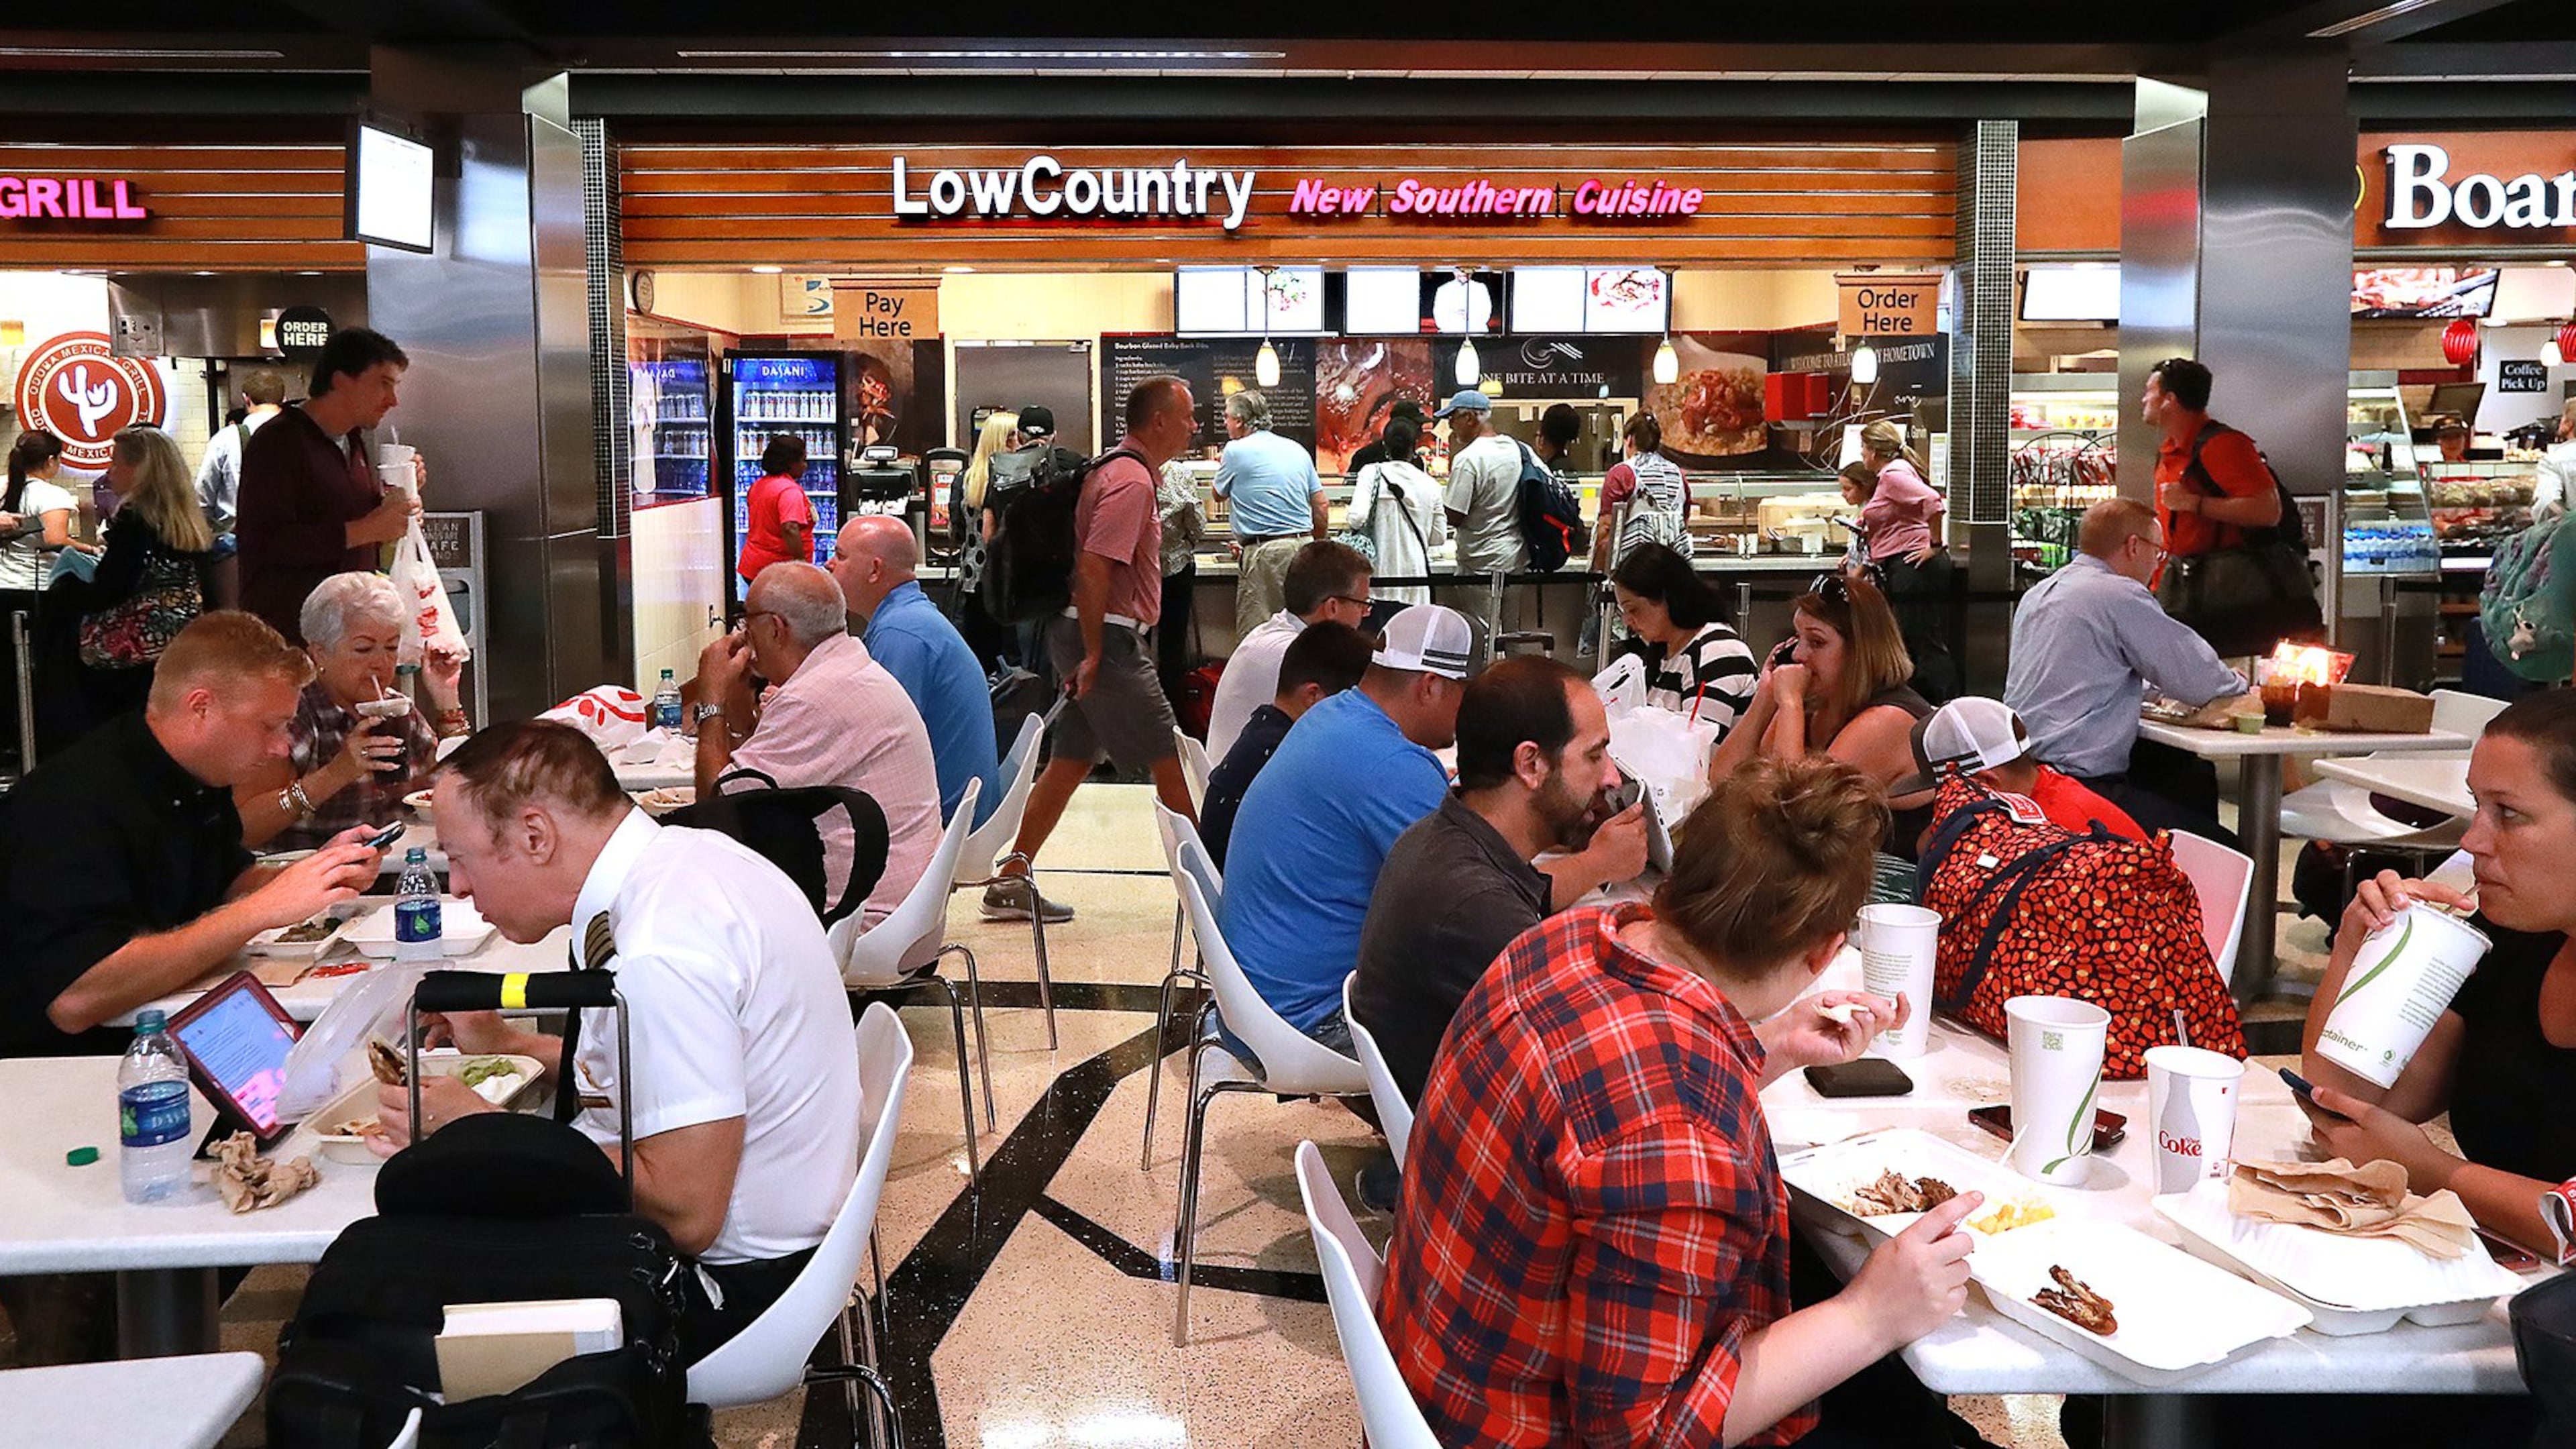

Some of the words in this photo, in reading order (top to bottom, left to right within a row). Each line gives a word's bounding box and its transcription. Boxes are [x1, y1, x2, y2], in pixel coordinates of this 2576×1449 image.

[0, 177, 146, 219] GRILL
[892, 154, 1256, 230] LowCountry
[1290, 178, 1375, 213] New
[1390, 178, 1554, 214] Southern
[1574, 179, 1704, 214] Cuisine
[866, 292, 904, 318] Pay
[1858, 288, 1919, 309] Order
[282, 321, 328, 333] ORDER
[859, 317, 912, 337] Here
[1863, 313, 1913, 332] Here
[283, 332, 329, 347] HERE
[1883, 343, 1935, 363] HOMETOWN
[60, 344, 119, 363] MEXICA
[121, 362, 147, 396] GRILL
[761, 366, 805, 377] DASANI
[1505, 372, 1536, 384] BITE
[1537, 372, 1556, 384] AT
[1558, 373, 1568, 384] A
[1570, 372, 1605, 384] TIME
[2504, 363, 2543, 376] Coffee
[2502, 378, 2524, 389] Pick
[2528, 378, 2546, 391] Up
[429, 540, 460, 551] AFE
[2159, 1130, 2202, 1157] Coke
